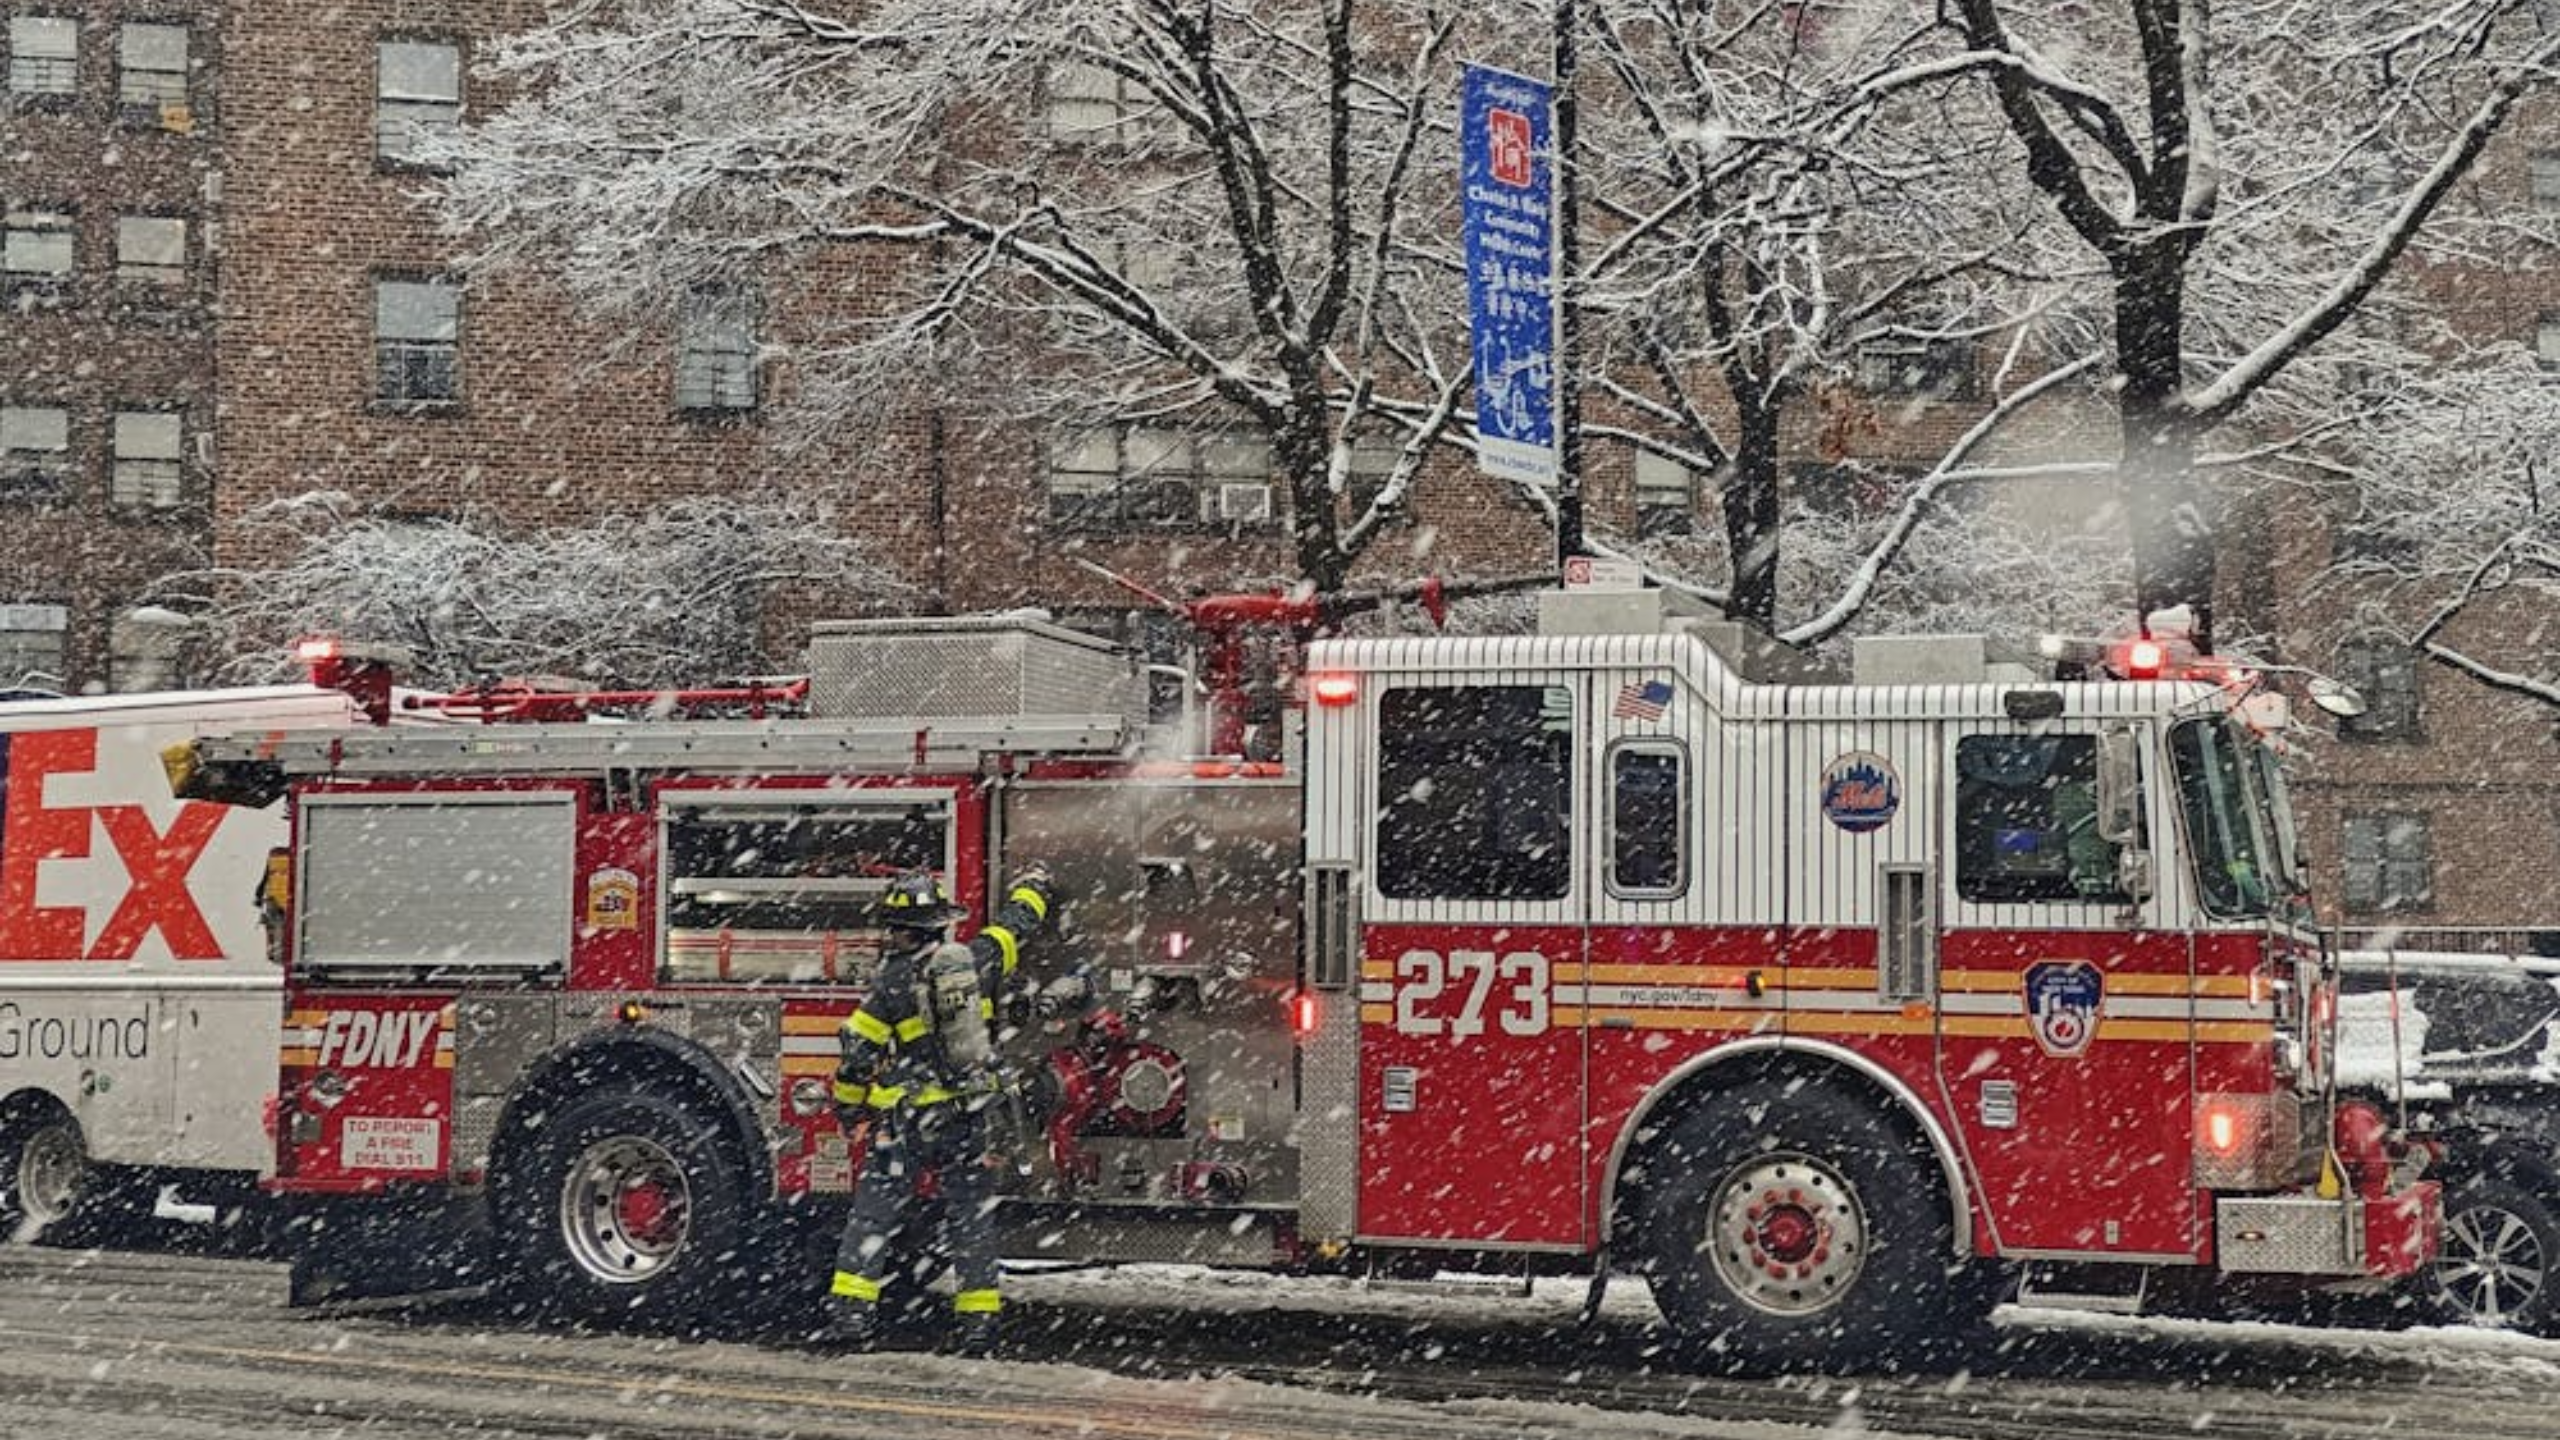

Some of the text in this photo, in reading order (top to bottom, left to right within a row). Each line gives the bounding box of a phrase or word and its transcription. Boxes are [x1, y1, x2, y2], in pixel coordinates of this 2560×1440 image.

[0, 727, 231, 960] Ex
[1397, 950, 1549, 1035] 273
[0, 1001, 149, 1058] Ground
[319, 1010, 439, 1068] FDNY
[348, 1121, 369, 1133] TO
[366, 1136, 413, 1149] A FIRE
[355, 1152, 424, 1165] DIAL 911
